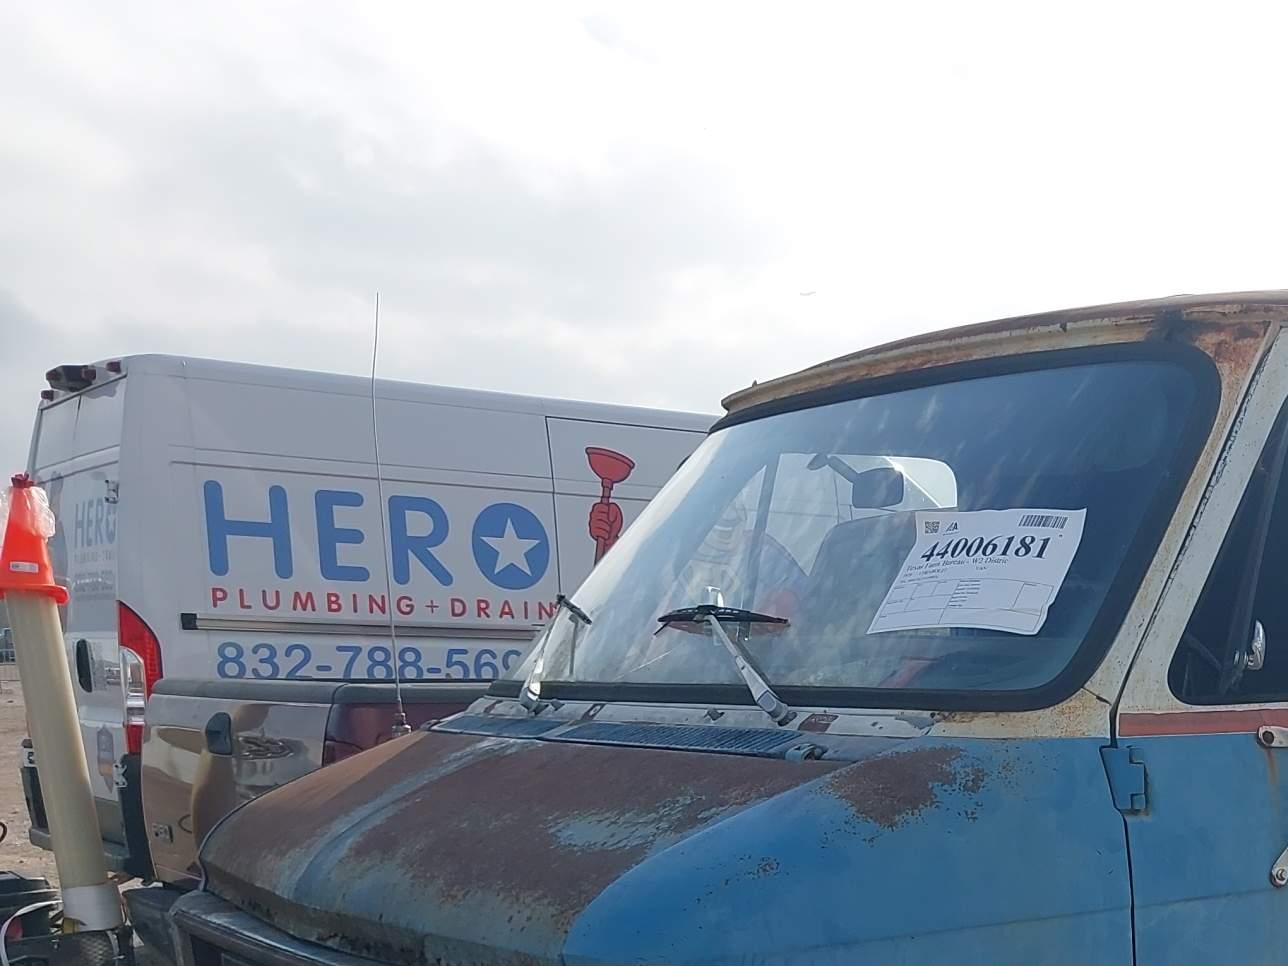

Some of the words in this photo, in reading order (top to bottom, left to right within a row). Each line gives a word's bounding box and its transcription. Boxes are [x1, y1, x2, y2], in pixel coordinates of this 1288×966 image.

[203, 480, 550, 590] HERO
[920, 534, 1051, 562] 44006181
[210, 587, 558, 620] PLUMBING+DRAIN
